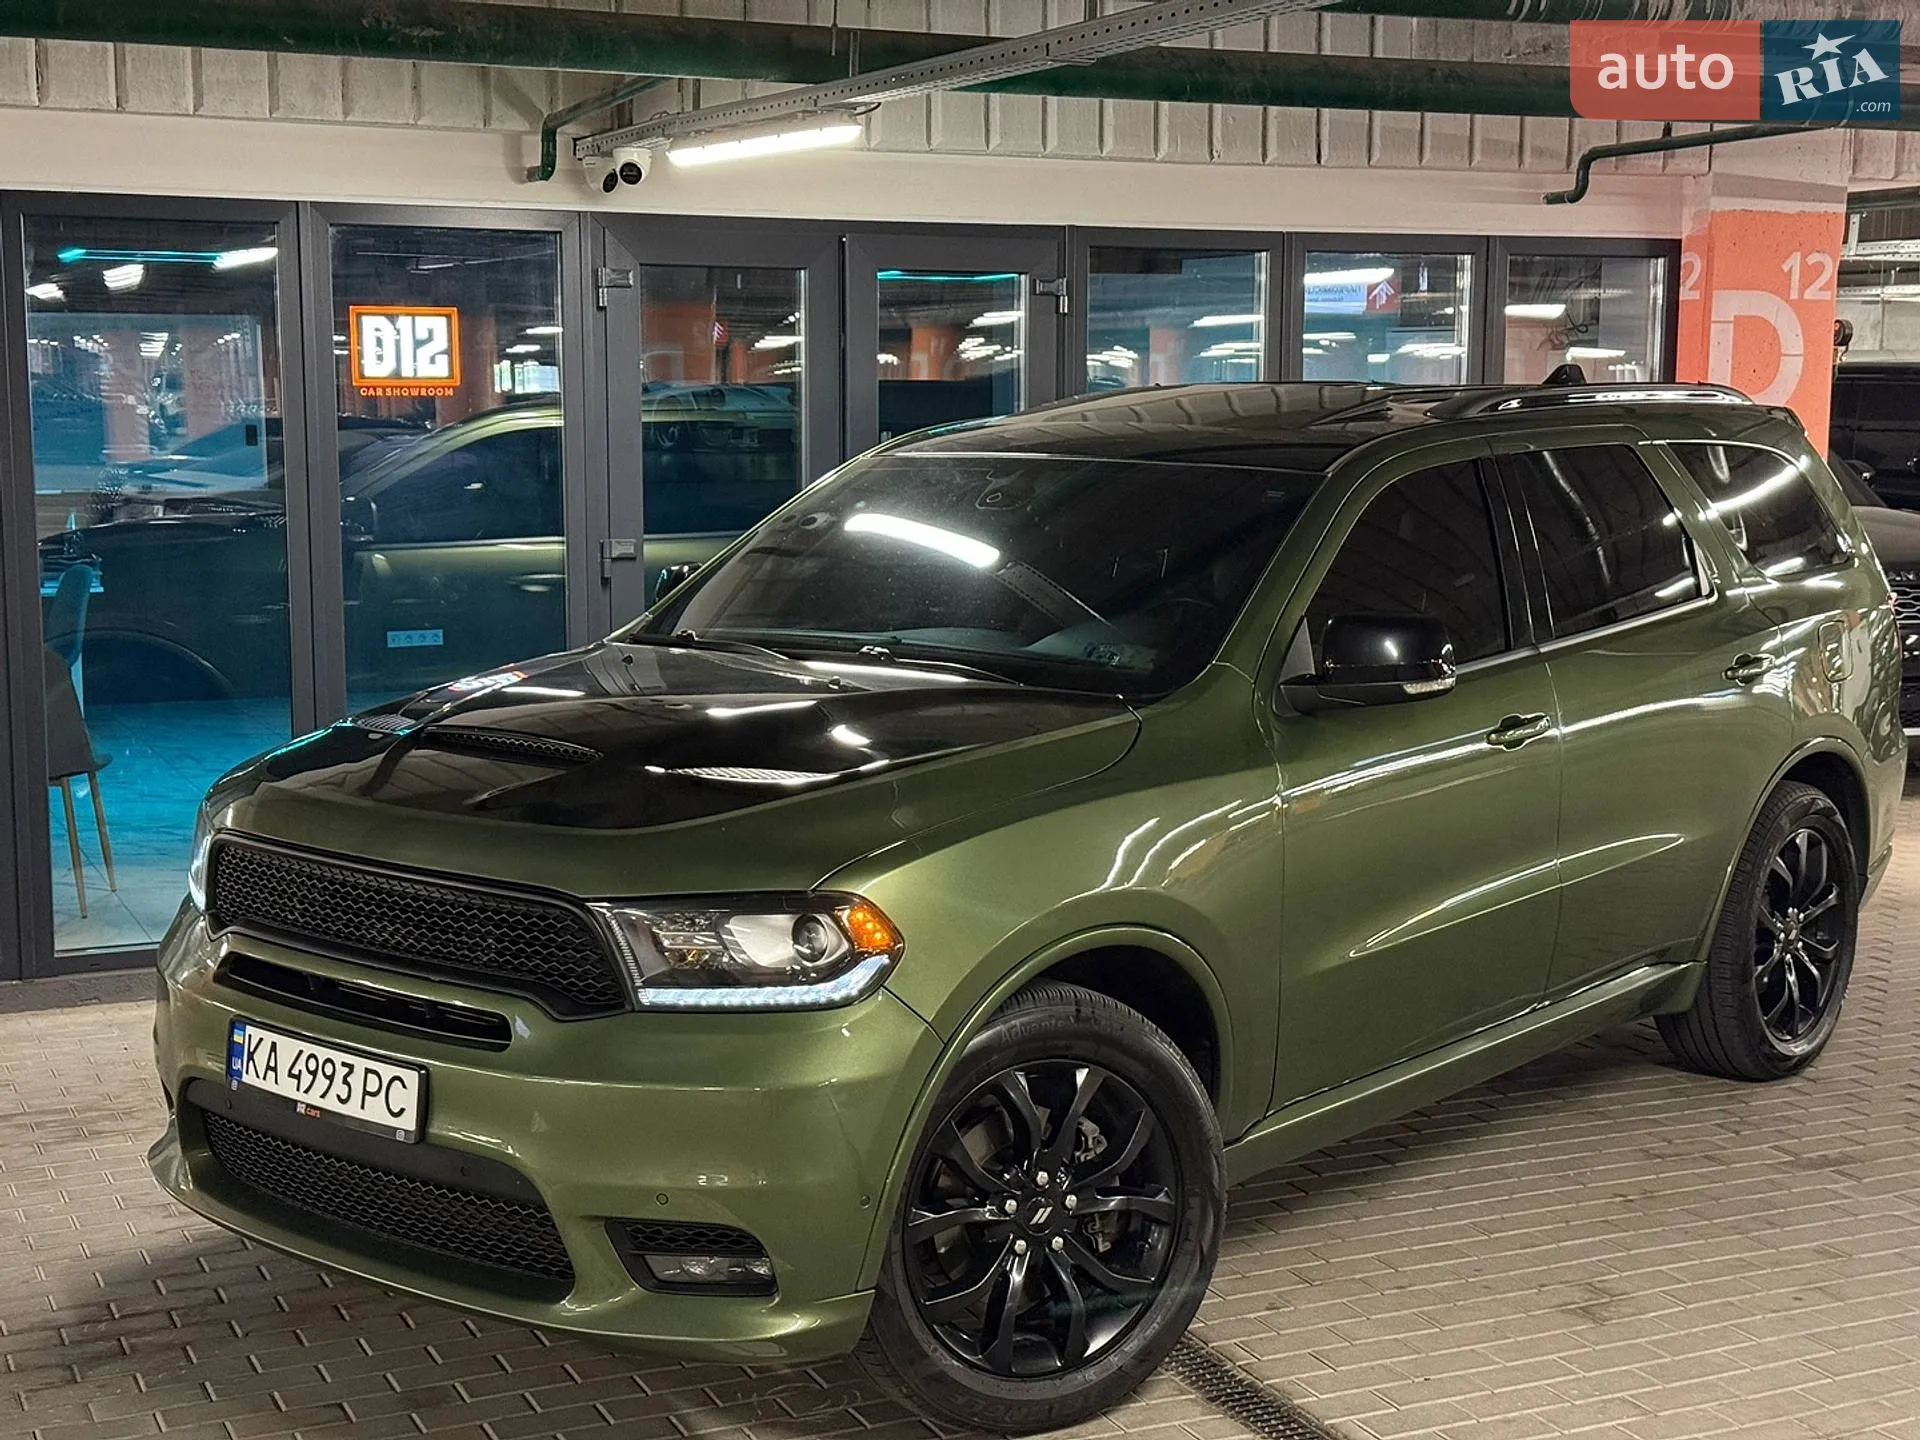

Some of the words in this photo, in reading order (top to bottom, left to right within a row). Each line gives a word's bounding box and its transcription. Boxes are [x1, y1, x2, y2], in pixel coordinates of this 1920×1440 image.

[1680, 251, 1702, 300] 2
[1781, 251, 1834, 300] 12
[361, 315, 450, 378] D12
[1708, 289, 1804, 406] D
[360, 387, 383, 396] CAR
[385, 387, 454, 396] SHOWROOM
[231, 1056, 243, 1071] UA
[245, 1033, 279, 1086] KA
[287, 1049, 355, 1106] 4993
[360, 1066, 408, 1119] PC
